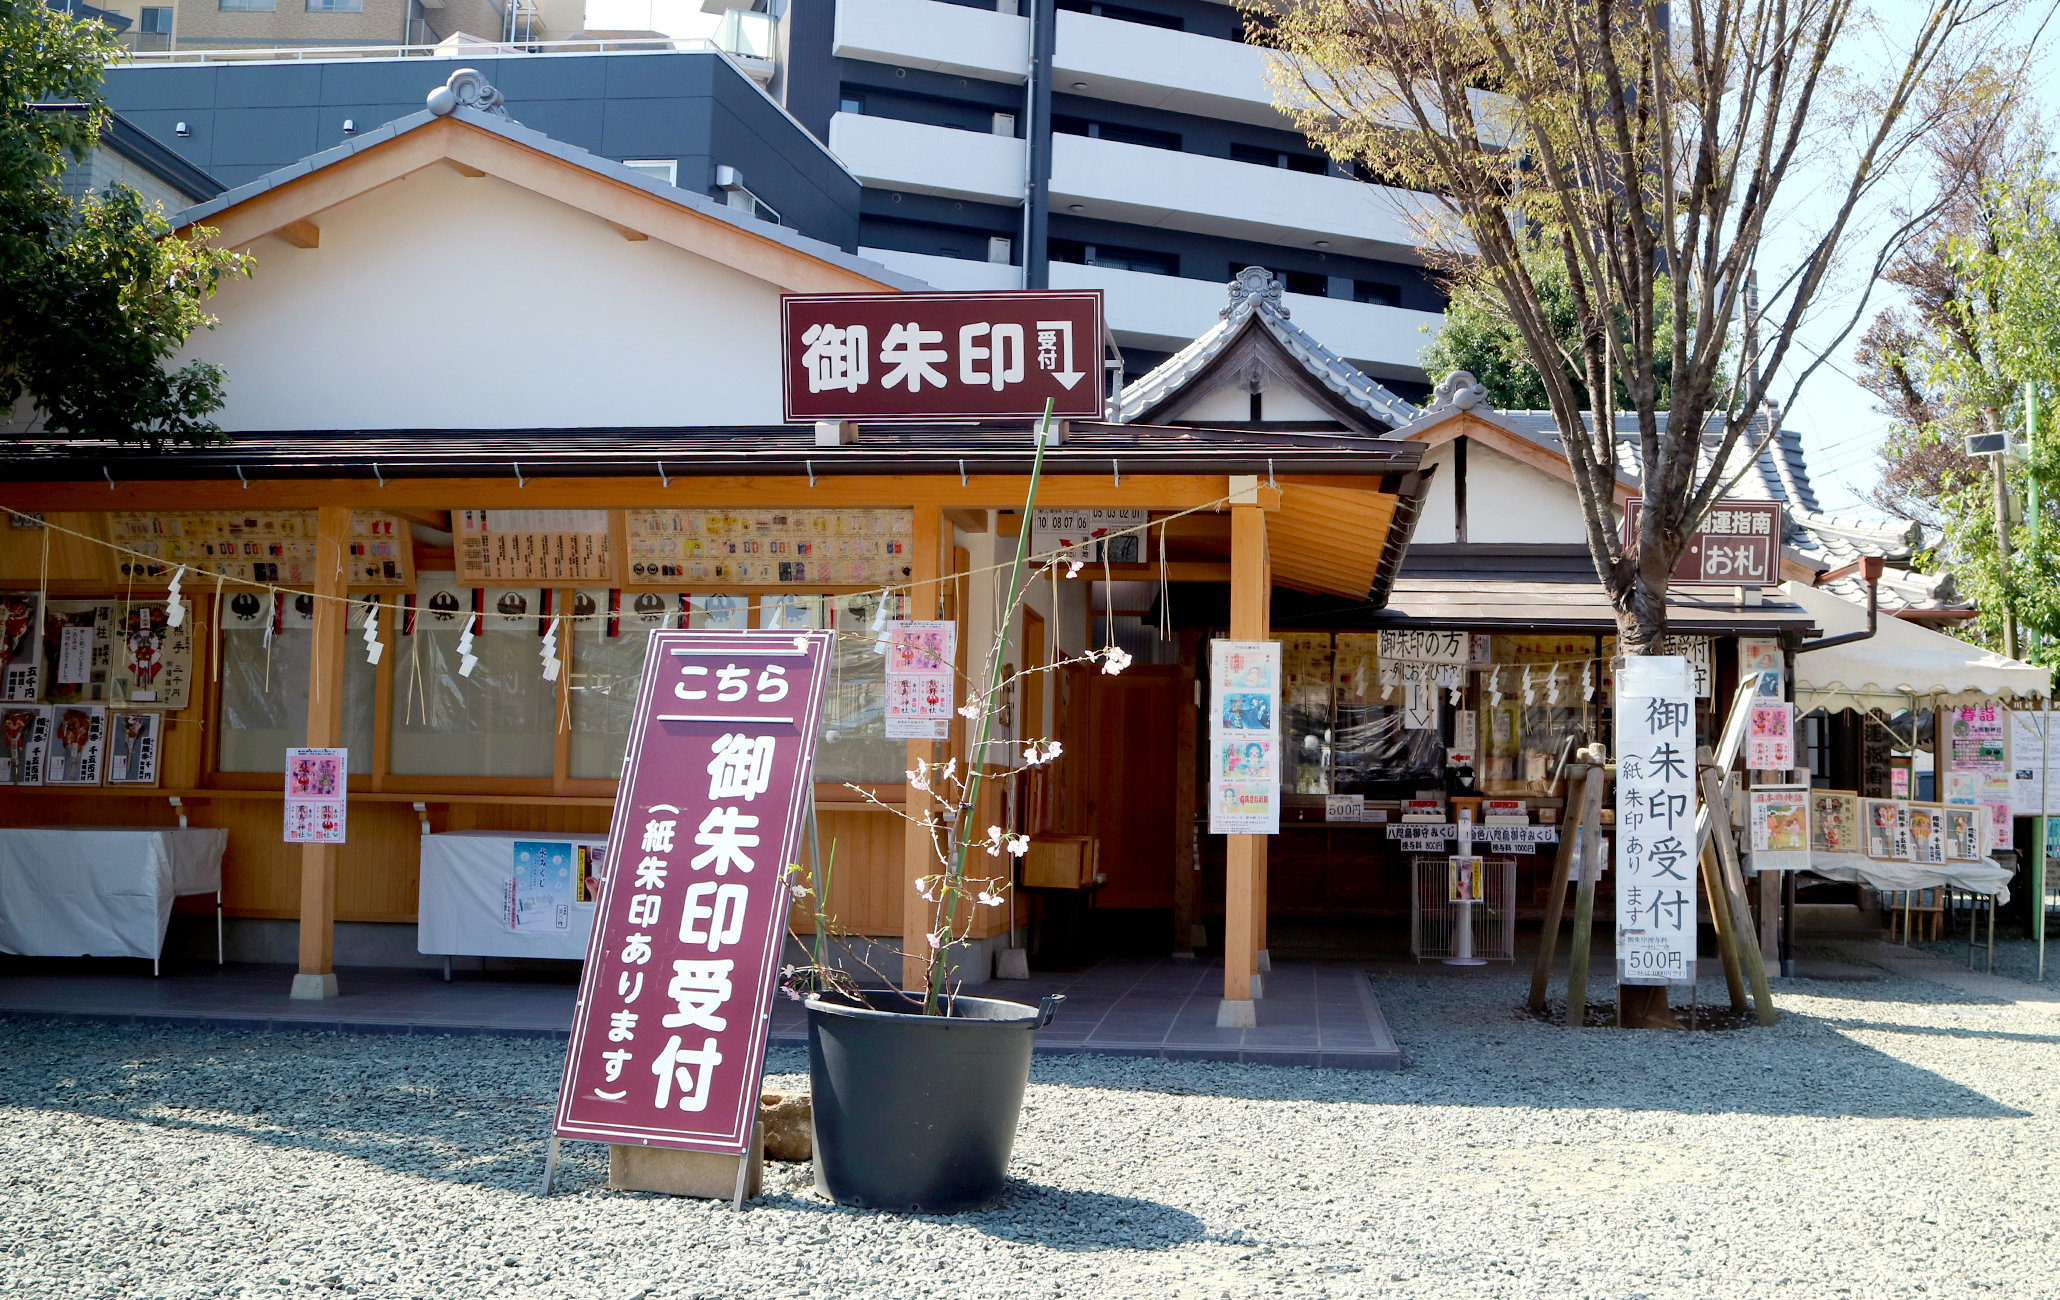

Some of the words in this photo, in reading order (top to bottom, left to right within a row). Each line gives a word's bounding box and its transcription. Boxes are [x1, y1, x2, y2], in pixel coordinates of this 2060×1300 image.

[801, 322, 1025, 394] 御朱印
[1037, 331, 1058, 371] 受付
[1038, 517, 1047, 528] 10
[1064, 517, 1074, 528] 07
[1706, 544, 1764, 576] お札
[1380, 632, 1463, 658] 御朱印の方
[25, 666, 37, 698] 五千円
[674, 663, 790, 703] こちら
[1329, 804, 1361, 816] 500円
[1757, 793, 1804, 802] 日本の神話
[1645, 697, 1690, 931] 御朱印受付
[1515, 844, 1535, 853] 1000円
[539, 847, 547, 888] 水みくじ
[651, 733, 776, 1112] 御朱印受付
[594, 803, 680, 1101] （紙朱印あります）
[1630, 951, 1682, 970] 500円
